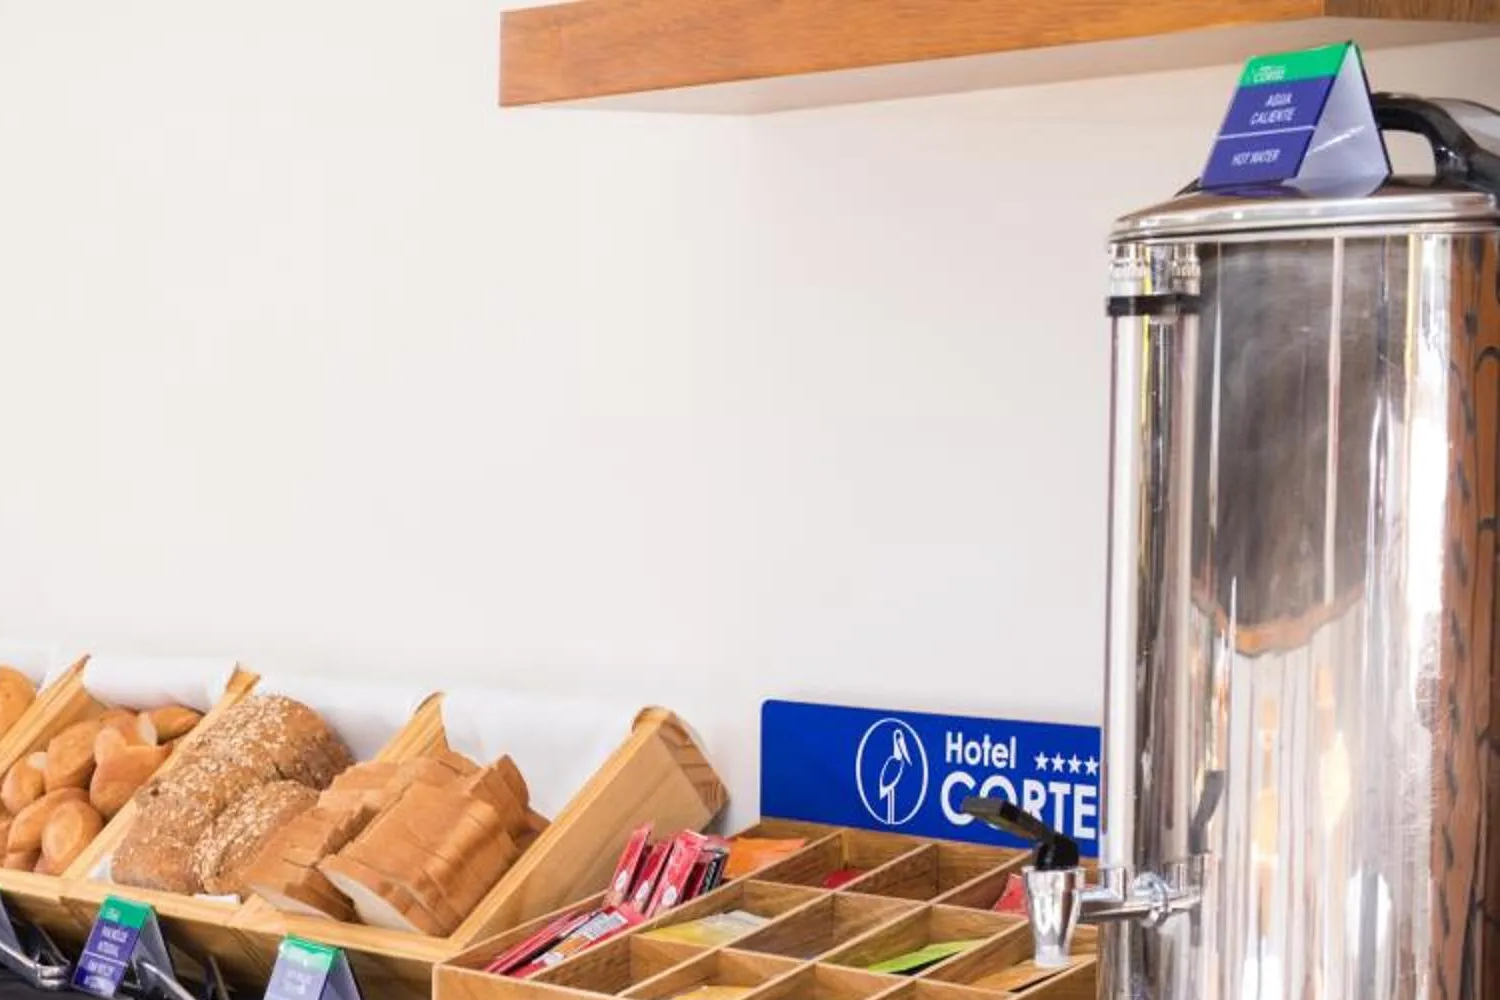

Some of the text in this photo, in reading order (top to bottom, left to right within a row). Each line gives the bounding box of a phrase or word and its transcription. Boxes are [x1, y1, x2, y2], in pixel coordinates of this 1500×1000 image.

[1251, 107, 1295, 125] CALIENTE
[1232, 152, 1249, 165] HOT
[945, 731, 1017, 770] Hotel
[940, 771, 1098, 839] CORTE
